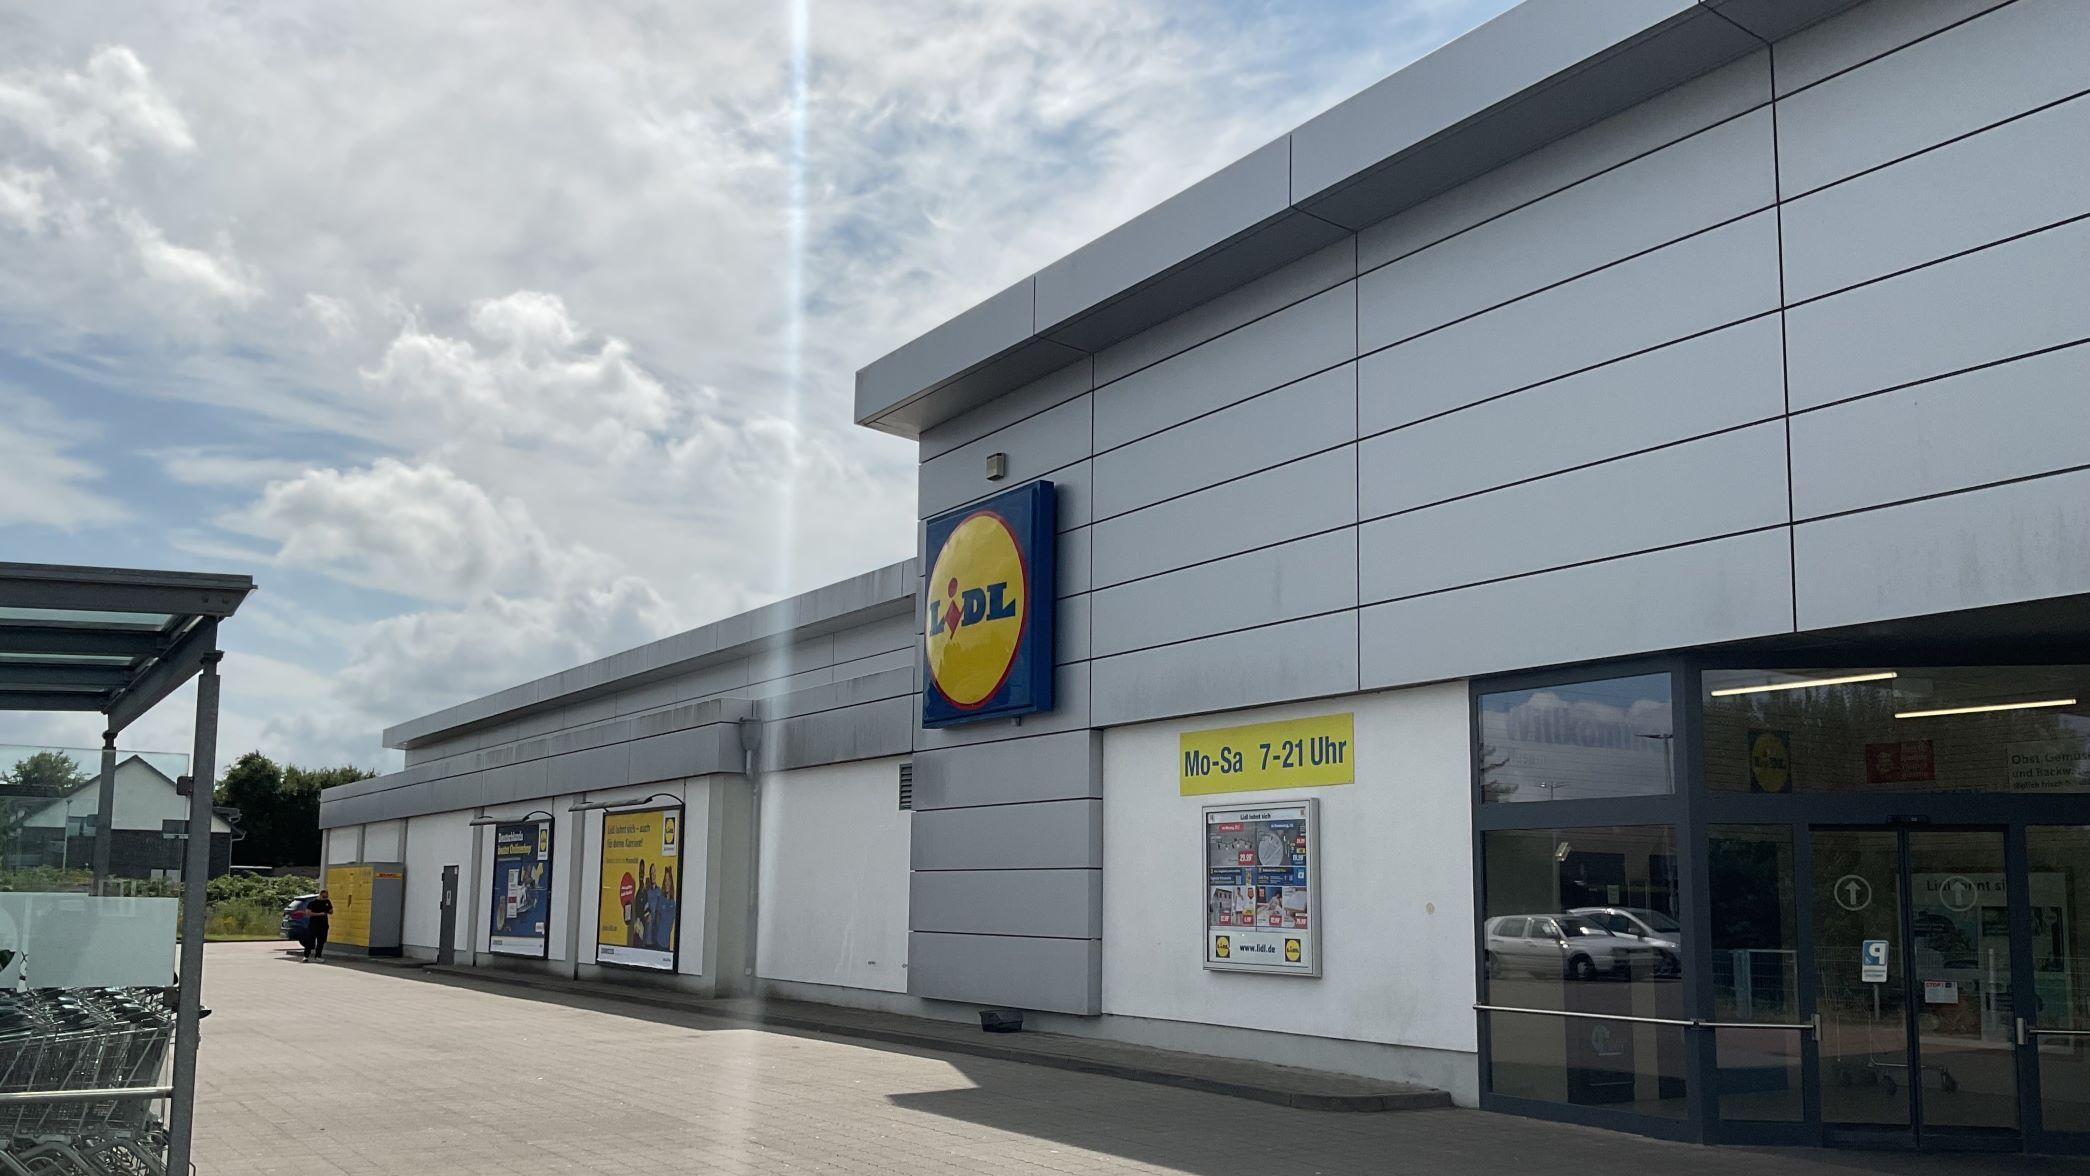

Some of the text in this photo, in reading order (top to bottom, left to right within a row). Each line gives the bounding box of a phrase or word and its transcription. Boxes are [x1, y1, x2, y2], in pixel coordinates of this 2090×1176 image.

[929, 577, 1016, 640] LIDL
[1185, 736, 1347, 777] Mo-Sa 7-21 Uhr
[2012, 768, 2033, 778] und
[1239, 943, 1276, 954] www.lidl.de
